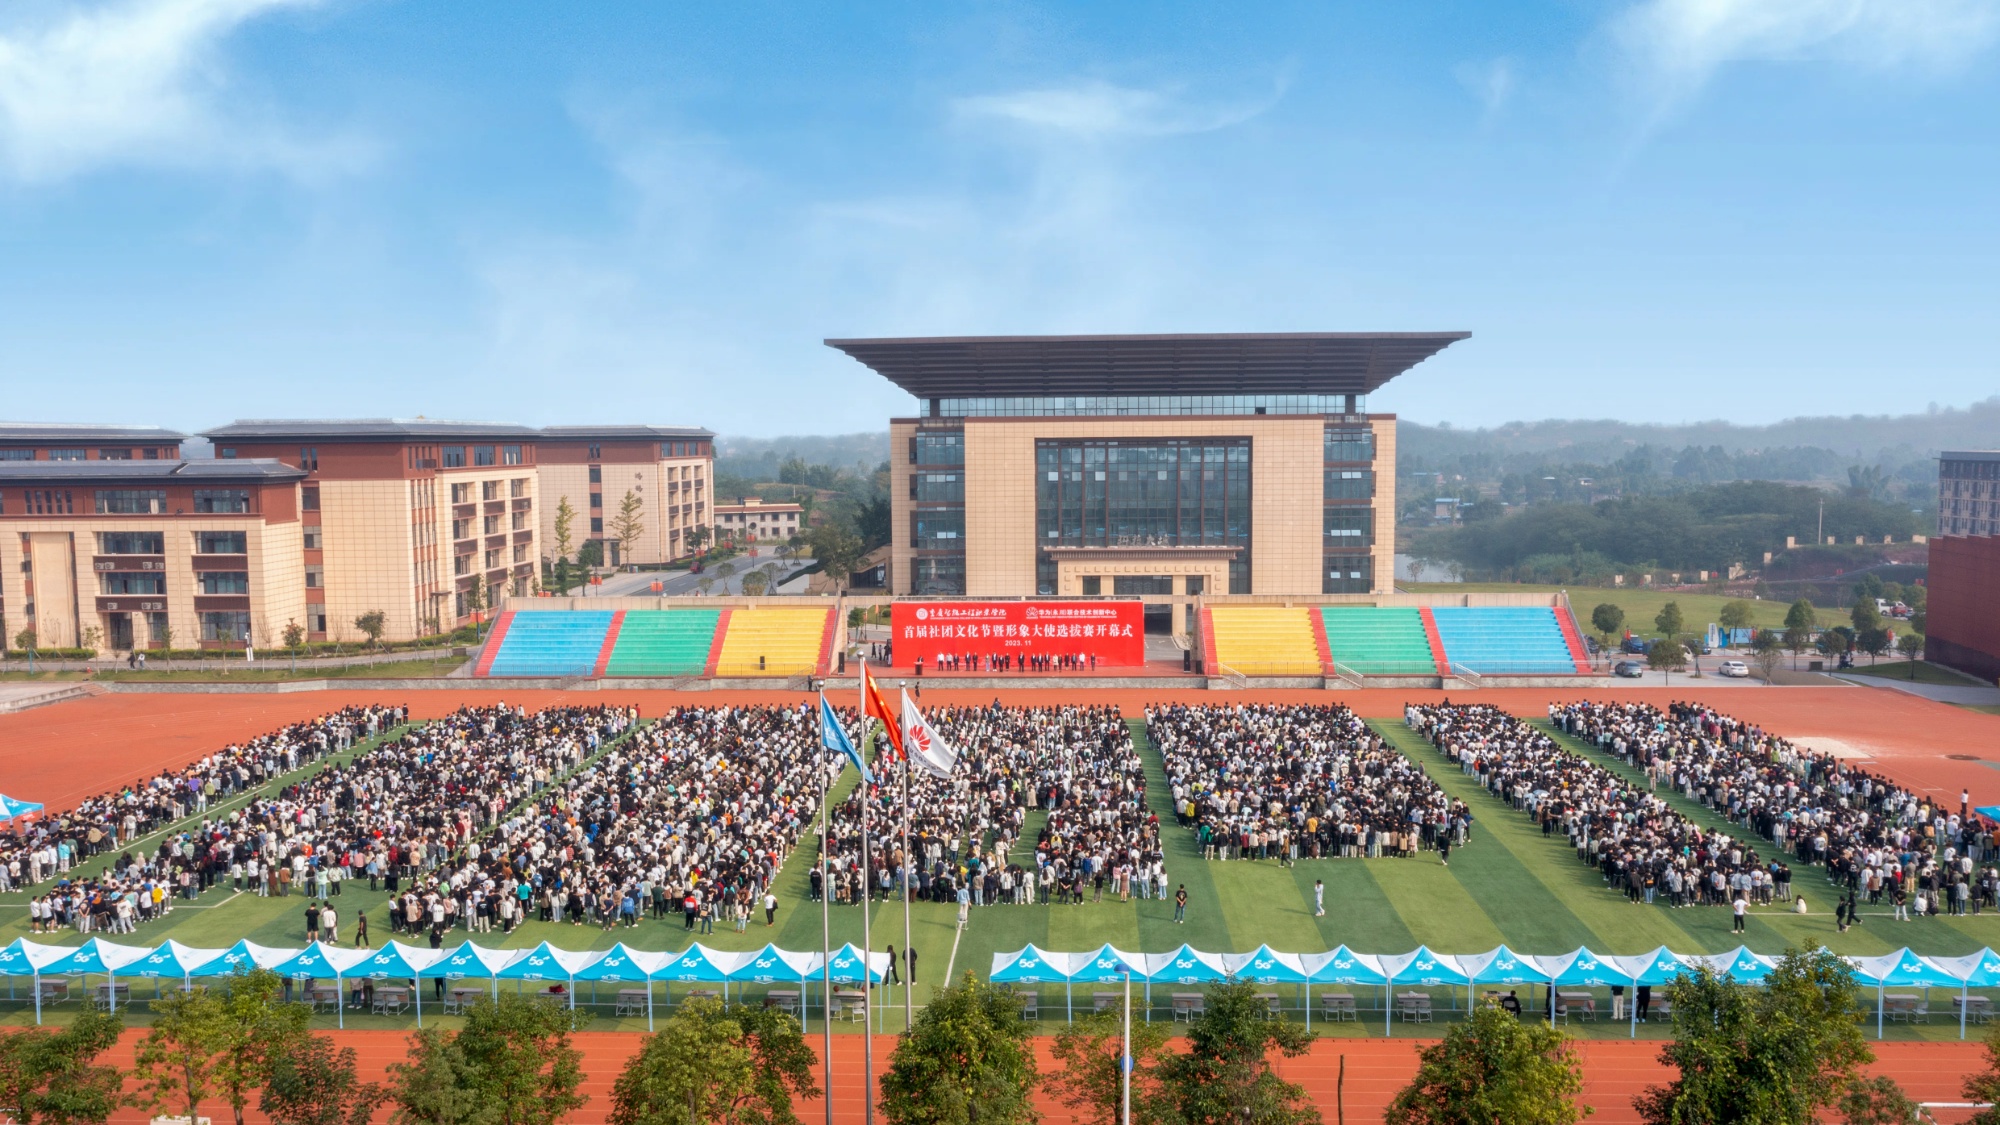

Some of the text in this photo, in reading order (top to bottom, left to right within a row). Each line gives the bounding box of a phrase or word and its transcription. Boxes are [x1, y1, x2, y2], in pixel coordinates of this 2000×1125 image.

[903, 624, 1133, 639] 首届社团文化节暨形象大使选拔赛开幕式
